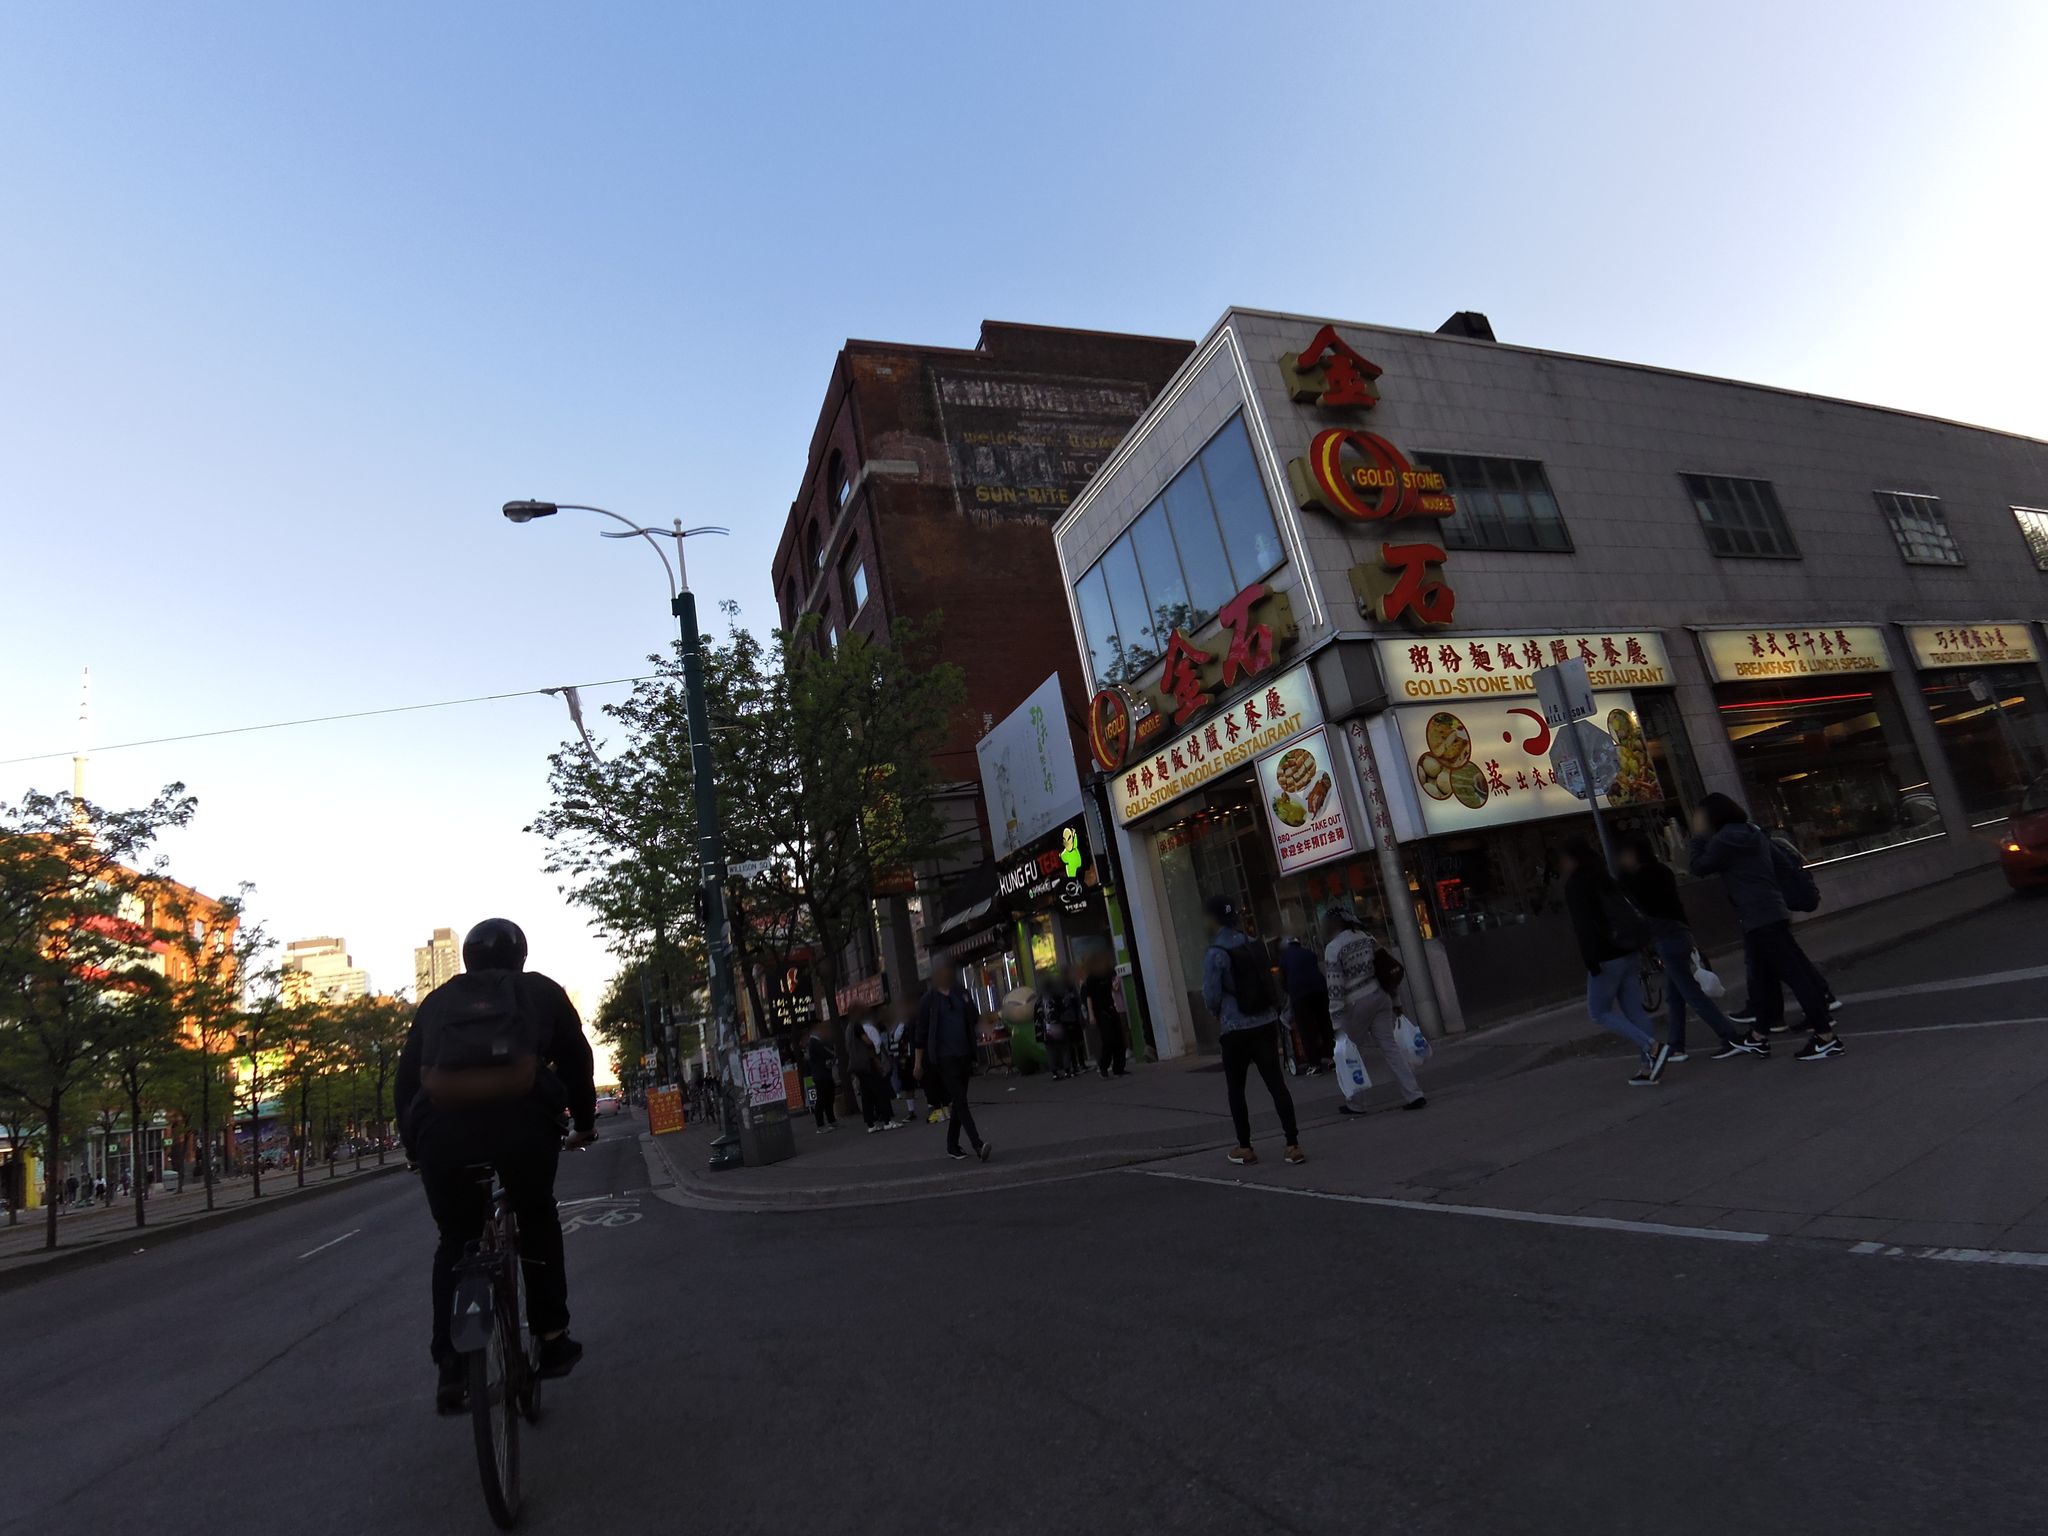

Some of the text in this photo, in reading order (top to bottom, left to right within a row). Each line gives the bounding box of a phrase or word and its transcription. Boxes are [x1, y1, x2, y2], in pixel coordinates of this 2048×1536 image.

[1357, 468, 1442, 490] GOLD STONE
[976, 485, 1071, 505] SUN-RITE
[1734, 656, 1880, 676] BREAKFAST & LUNCH SPECIAL
[1405, 675, 1512, 697] GOLD-STONE
[1587, 667, 1665, 686] ESTAURANT
[1106, 713, 1125, 738] GOLD
[1137, 714, 1161, 738] NOODLE
[1125, 712, 1302, 818] GOLD-STONE NOODLE RESTAURANT
[1311, 819, 1327, 832] TAKE
[1327, 813, 1341, 826] OUT
[999, 867, 1025, 897] KUNG
[1024, 859, 1038, 885] FU
